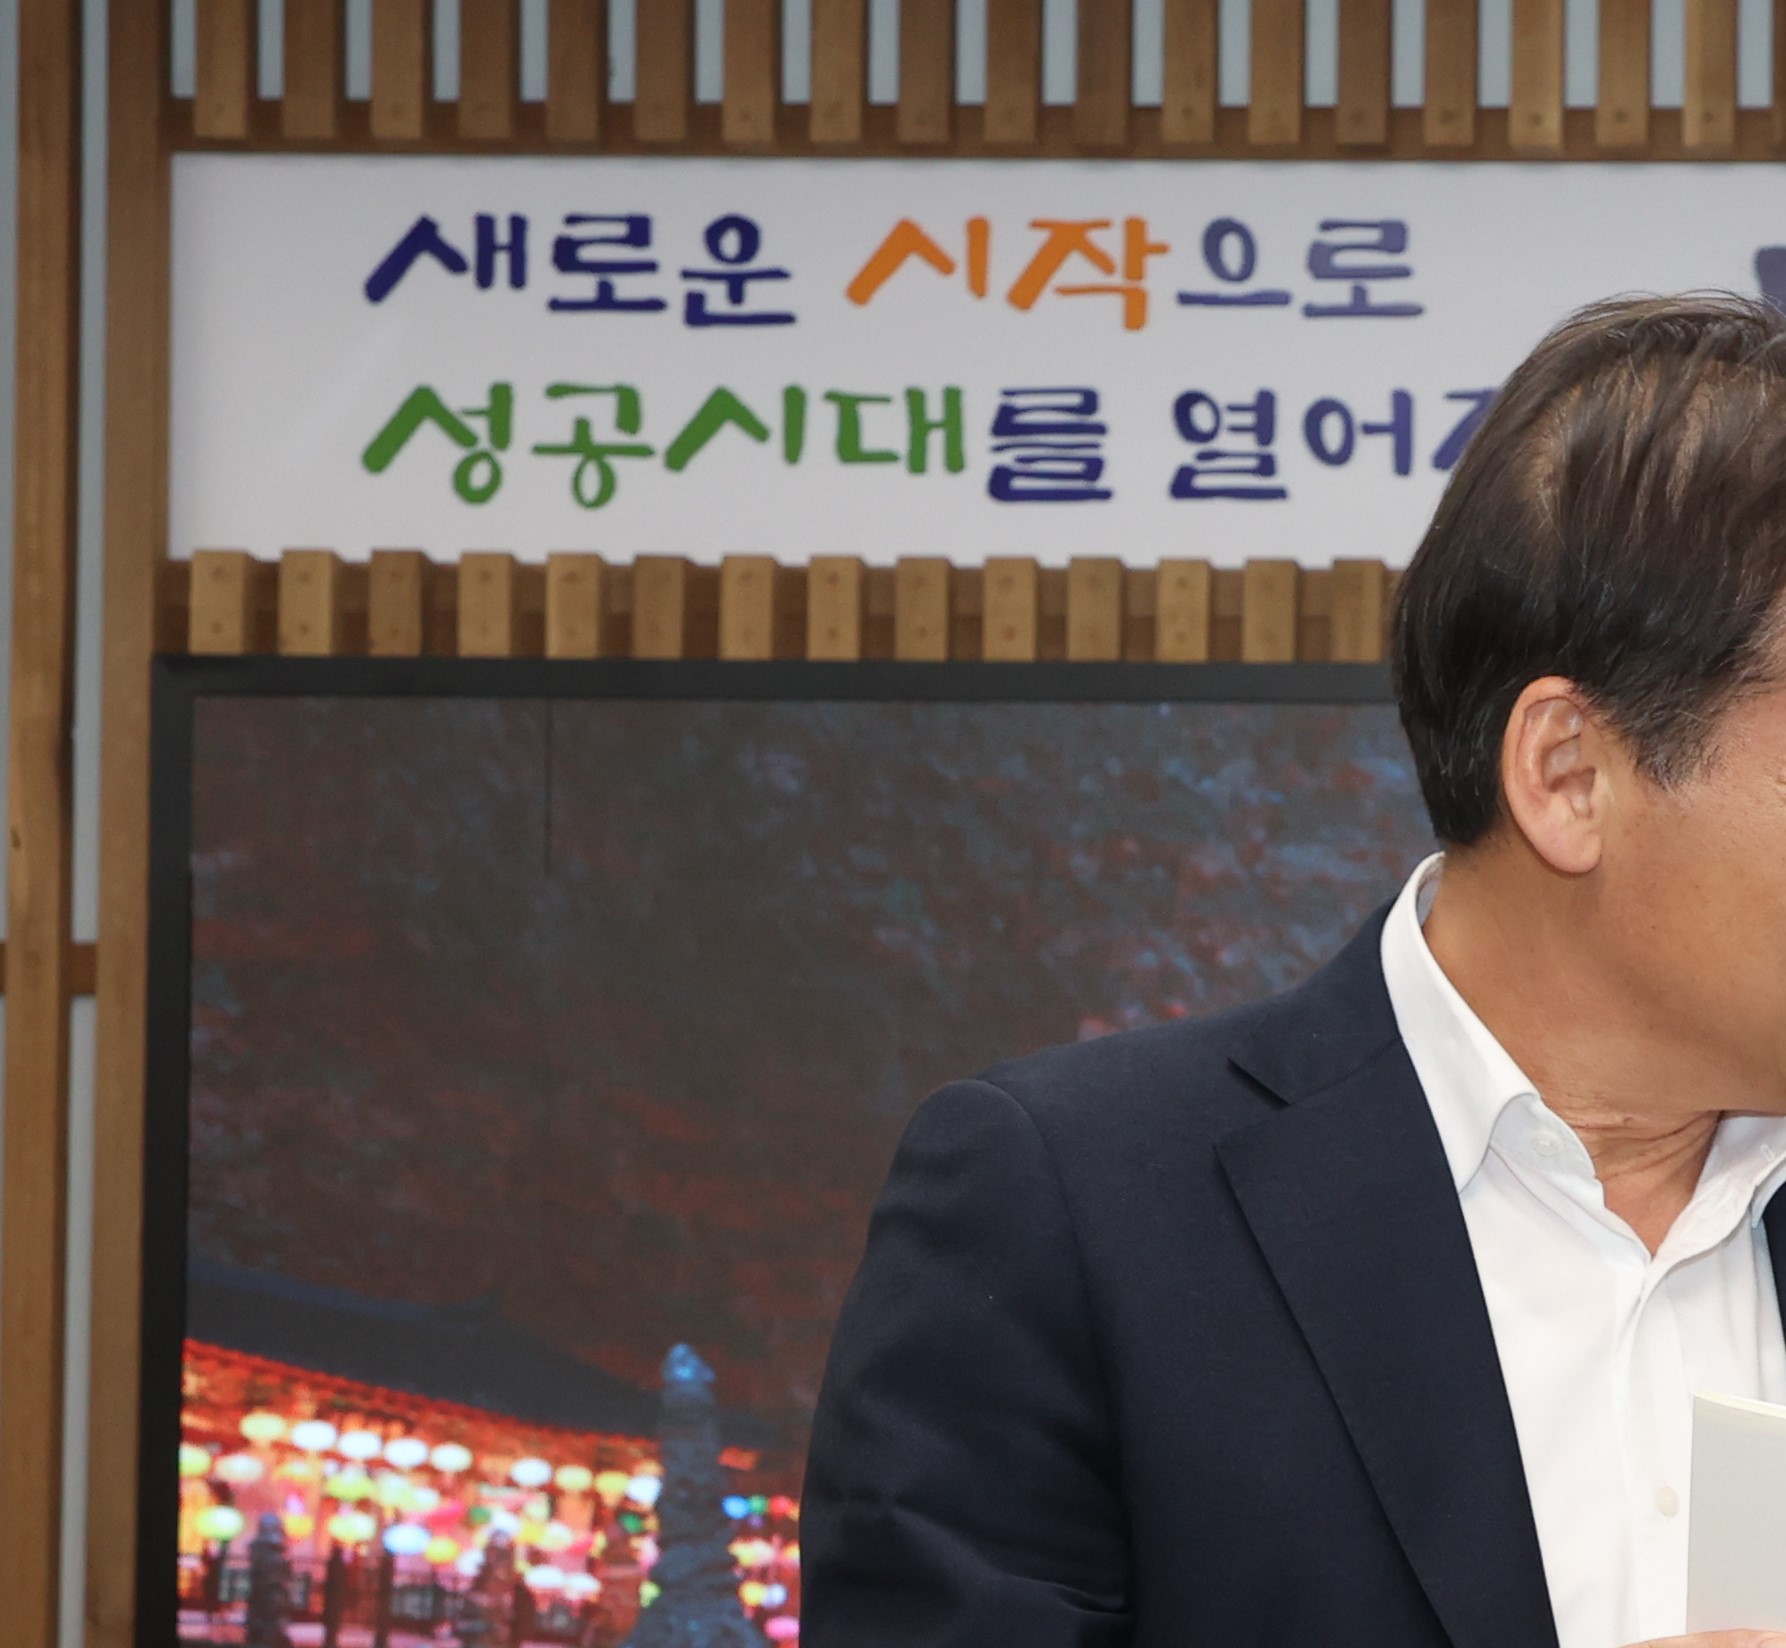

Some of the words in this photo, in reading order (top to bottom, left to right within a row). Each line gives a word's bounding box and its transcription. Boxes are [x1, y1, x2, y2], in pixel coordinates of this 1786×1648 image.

[366, 214, 796, 328] 새로운
[845, 215, 1424, 332] 시작으로
[363, 384, 1113, 506] 성공시대를
